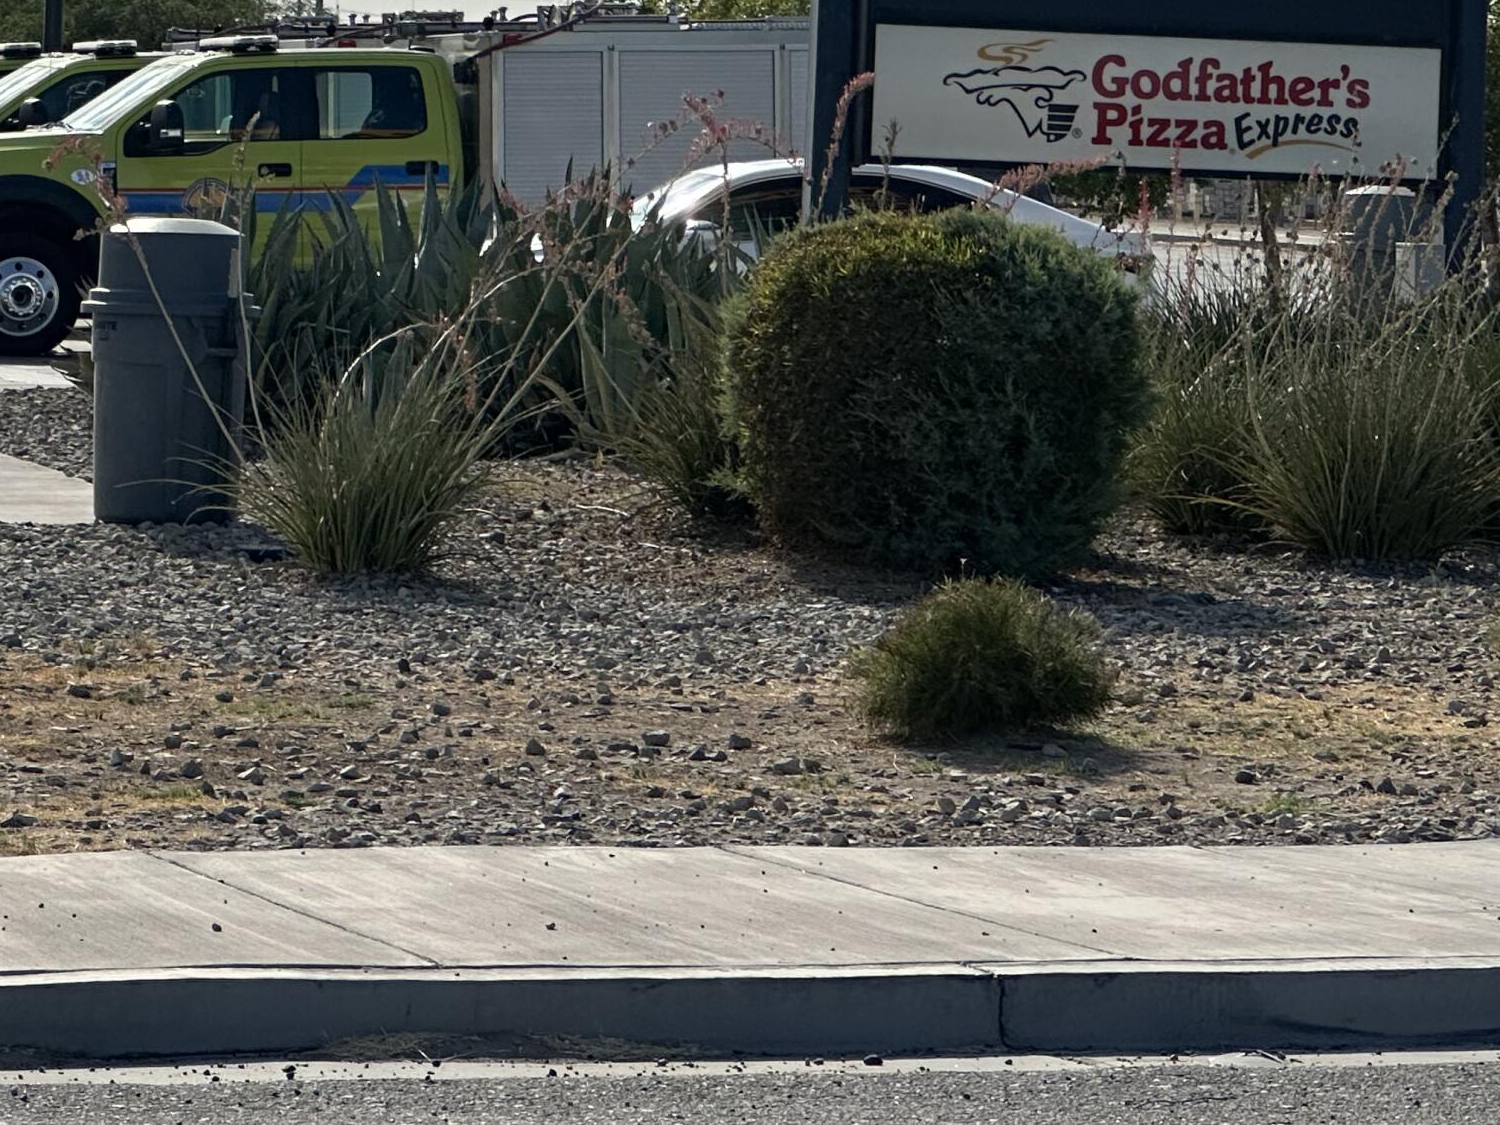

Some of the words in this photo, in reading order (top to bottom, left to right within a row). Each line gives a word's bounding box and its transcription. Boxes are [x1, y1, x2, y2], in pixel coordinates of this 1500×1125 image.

[1091, 54, 1371, 109] Godfather's
[1091, 102, 1228, 150] Pizza
[1233, 112, 1361, 151] Express
